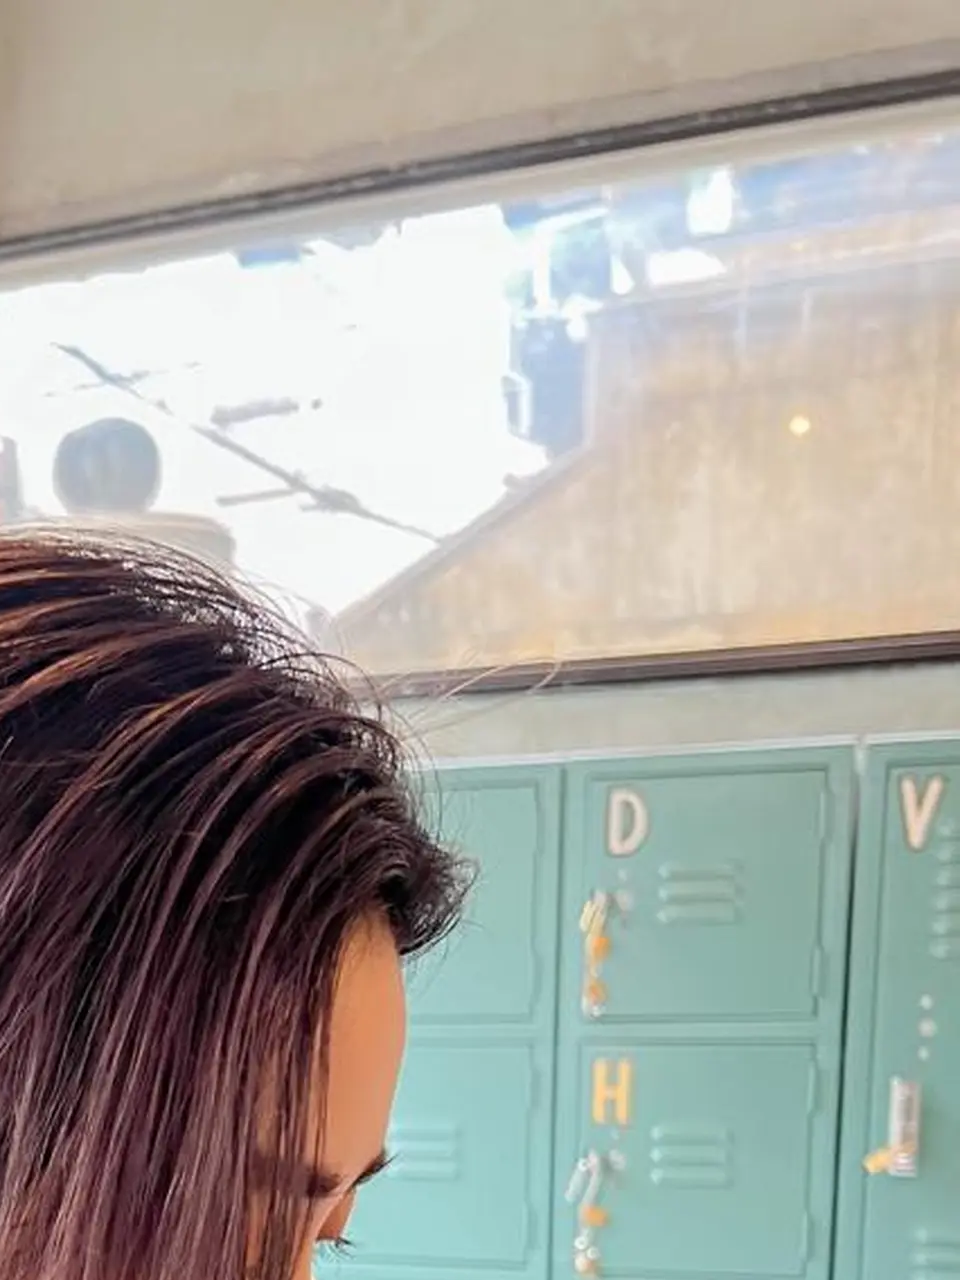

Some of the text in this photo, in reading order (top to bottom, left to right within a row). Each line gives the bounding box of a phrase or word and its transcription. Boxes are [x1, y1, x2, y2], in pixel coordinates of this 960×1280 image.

[606, 790, 649, 855] D
[900, 776, 943, 849] V
[593, 1058, 632, 1124] H
